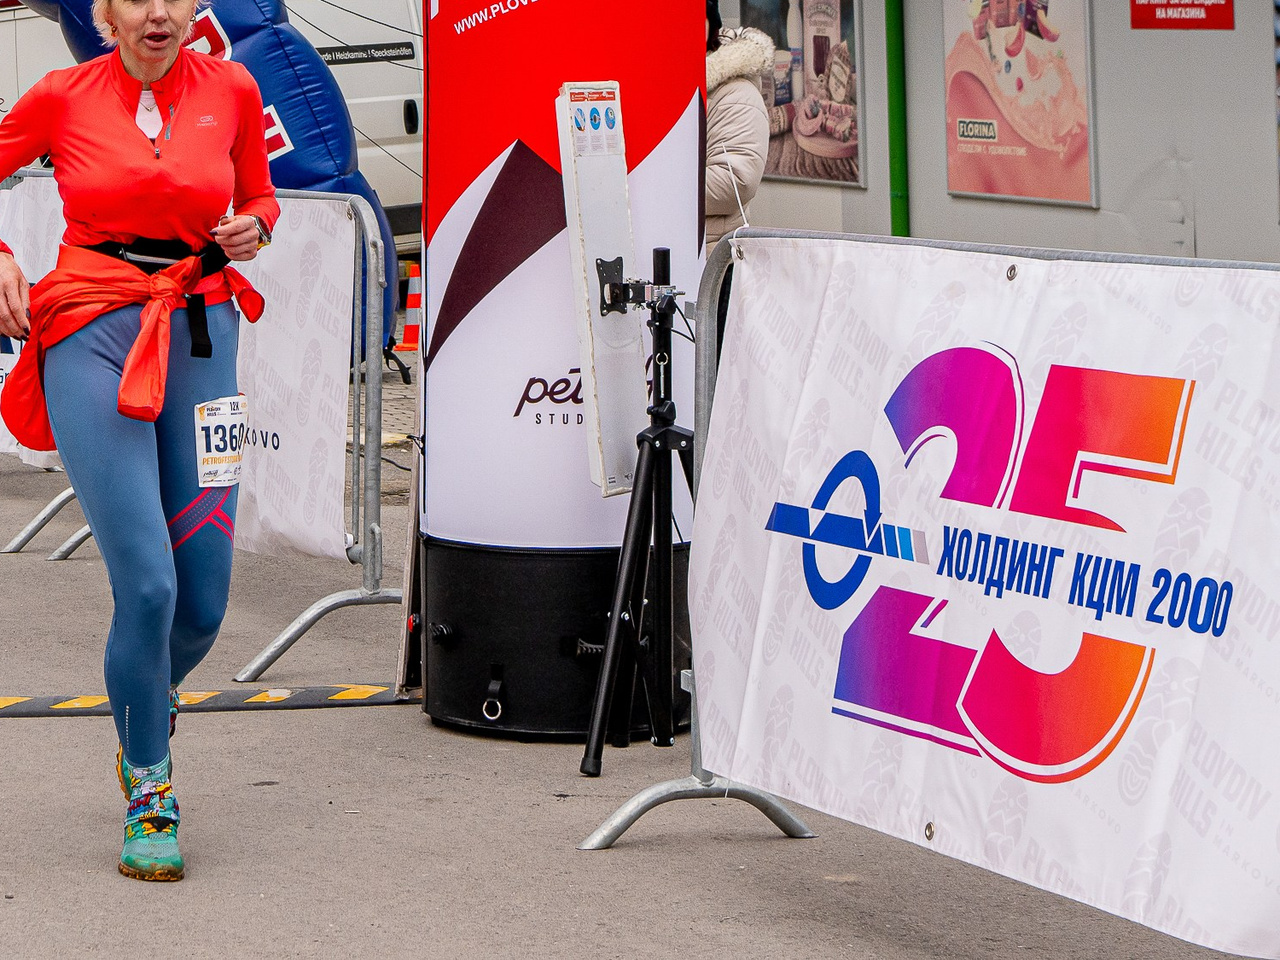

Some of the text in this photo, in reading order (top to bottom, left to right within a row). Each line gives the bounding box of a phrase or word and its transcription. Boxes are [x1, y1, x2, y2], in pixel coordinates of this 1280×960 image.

[1155, 7, 1206, 19] НА МАГАЗИНА
[958, 120, 996, 139] FLORINA
[535, 413, 584, 425] STUD
[245, 427, 280, 450] KOVO
[937, 525, 1234, 638] ХОЛДИНГ КЦМ 2000
